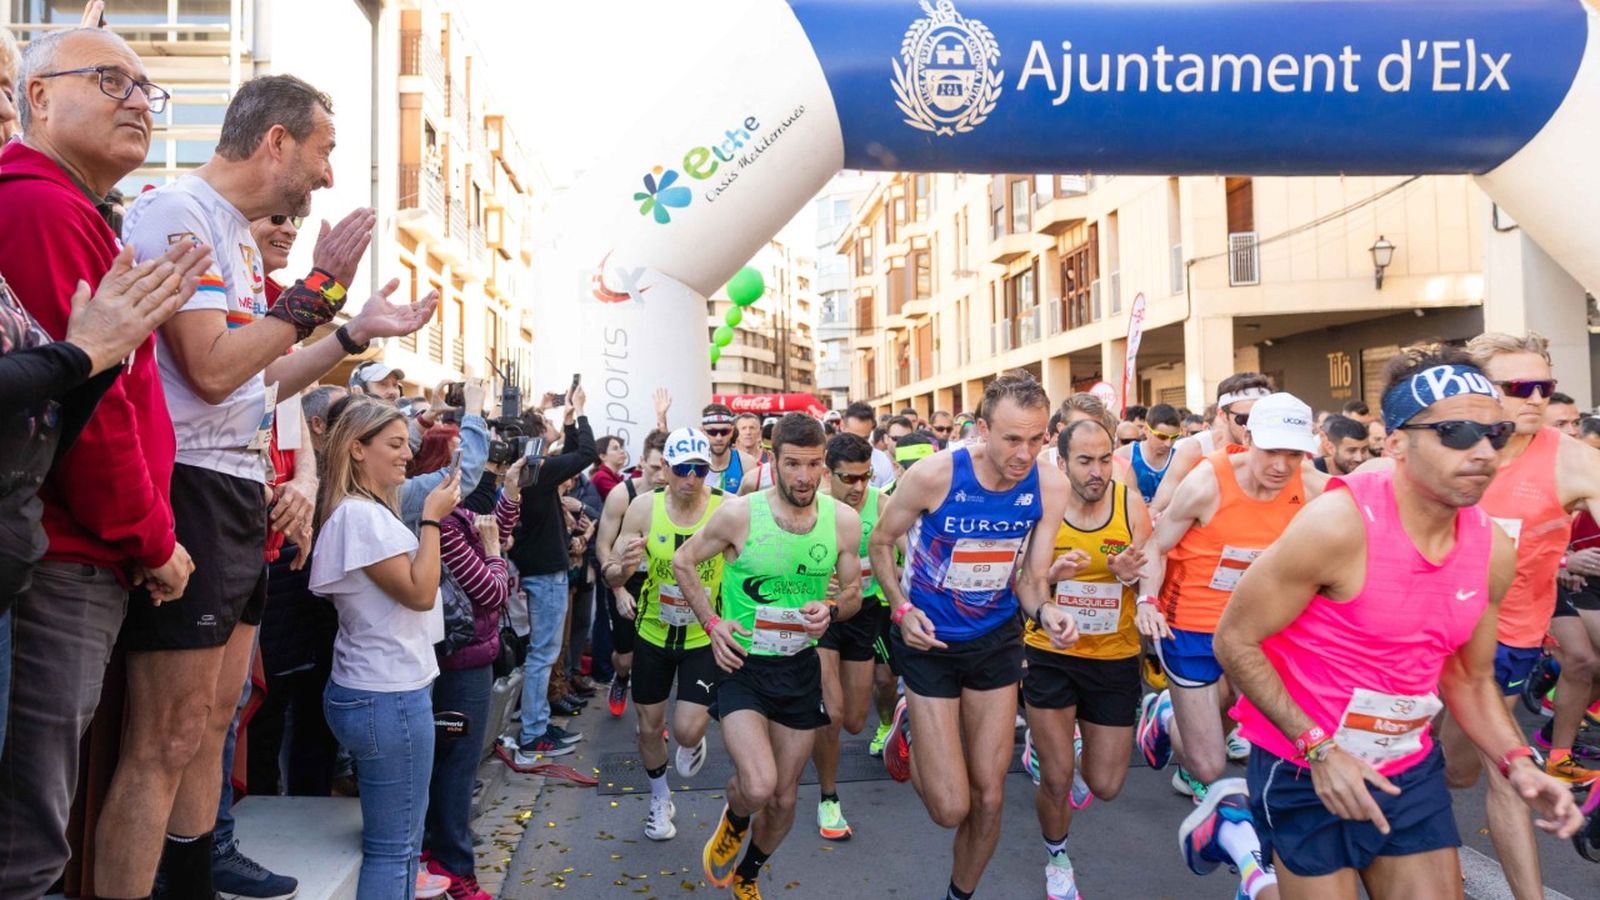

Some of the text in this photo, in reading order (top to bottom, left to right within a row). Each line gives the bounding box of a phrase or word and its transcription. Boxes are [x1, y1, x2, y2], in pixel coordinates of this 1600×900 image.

[1016, 38, 1512, 106] Ajuntament d'Elx
[682, 115, 760, 180] elche
[704, 171, 739, 203] Oasis
[601, 327, 638, 468] sports
[1059, 596, 1117, 608] BLASQUILES
[1078, 608, 1097, 617] 40
